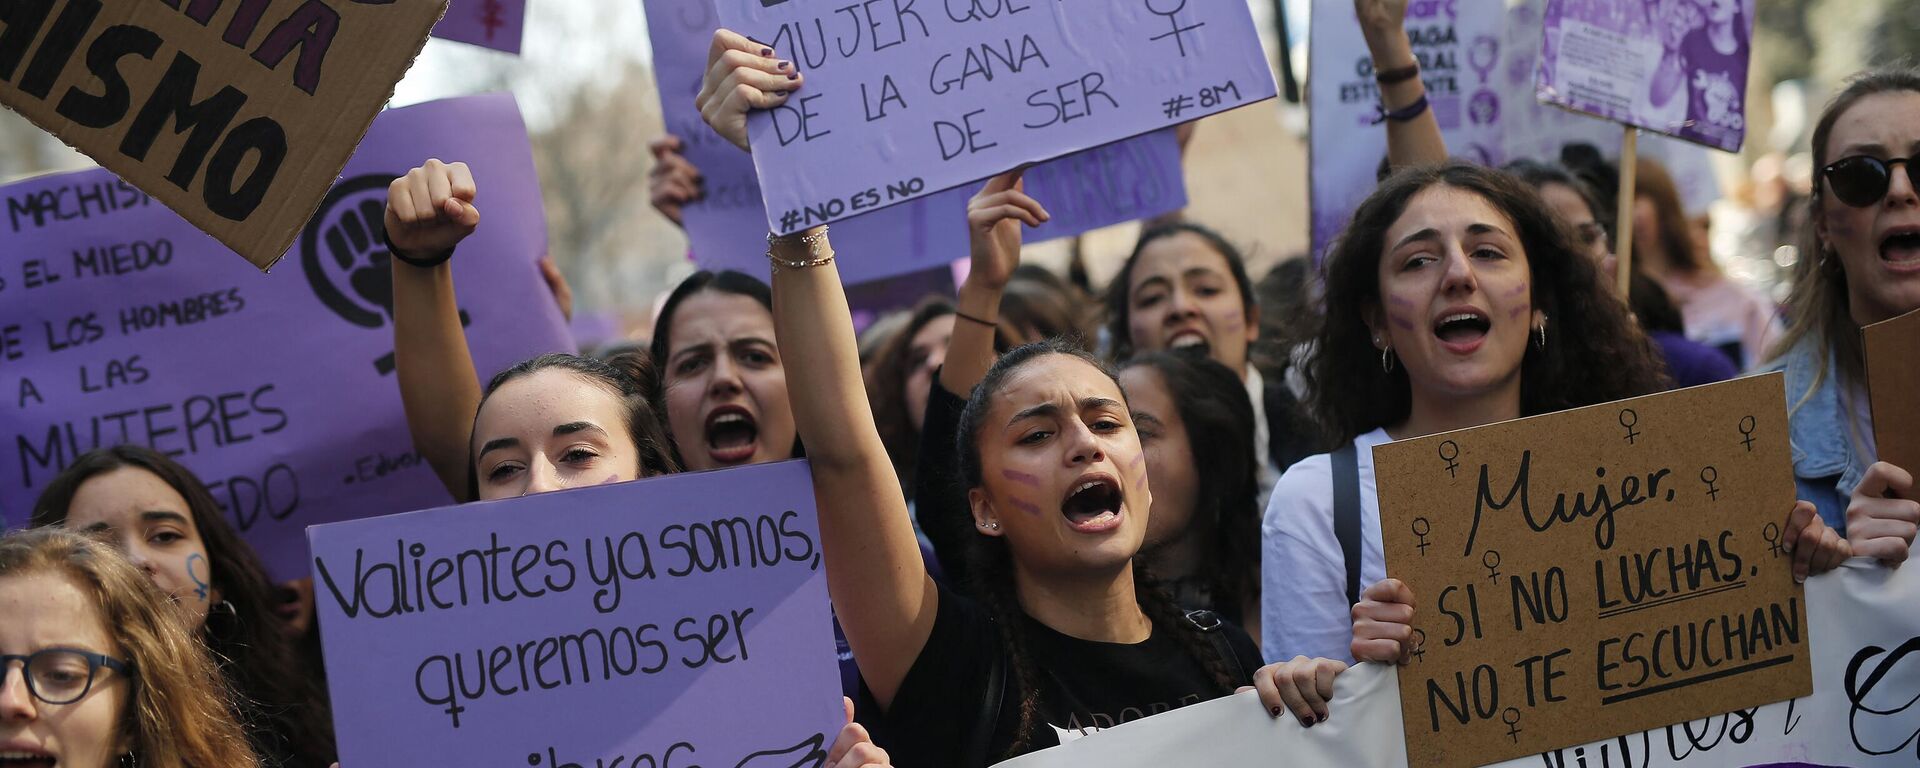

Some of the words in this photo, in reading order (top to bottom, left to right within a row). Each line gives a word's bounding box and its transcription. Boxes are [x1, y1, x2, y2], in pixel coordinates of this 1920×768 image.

[770, 93, 831, 147] DE
[861, 75, 907, 122] LA
[930, 34, 1049, 95] GANA
[933, 108, 997, 161] DE
[1023, 72, 1119, 128] SER
[851, 188, 881, 210] ES
[886, 177, 925, 200] NO
[22, 259, 61, 288] EL
[72, 238, 174, 278] MIEDO
[44, 312, 104, 352] LOS
[118, 287, 246, 336] HOMBRES
[19, 377, 43, 408] A
[79, 354, 150, 393] LAS
[1464, 450, 1675, 556] Mujer,
[315, 532, 576, 618] Valientes
[585, 530, 656, 613] ya
[659, 510, 821, 577] somos,
[1438, 583, 1482, 647] SI
[1510, 566, 1568, 631] NO
[415, 623, 668, 728] queremos
[674, 607, 754, 668] ser
[1426, 664, 1499, 732] NO
[1514, 648, 1571, 707] TE
[1597, 597, 1800, 690] ESCUCHAN
